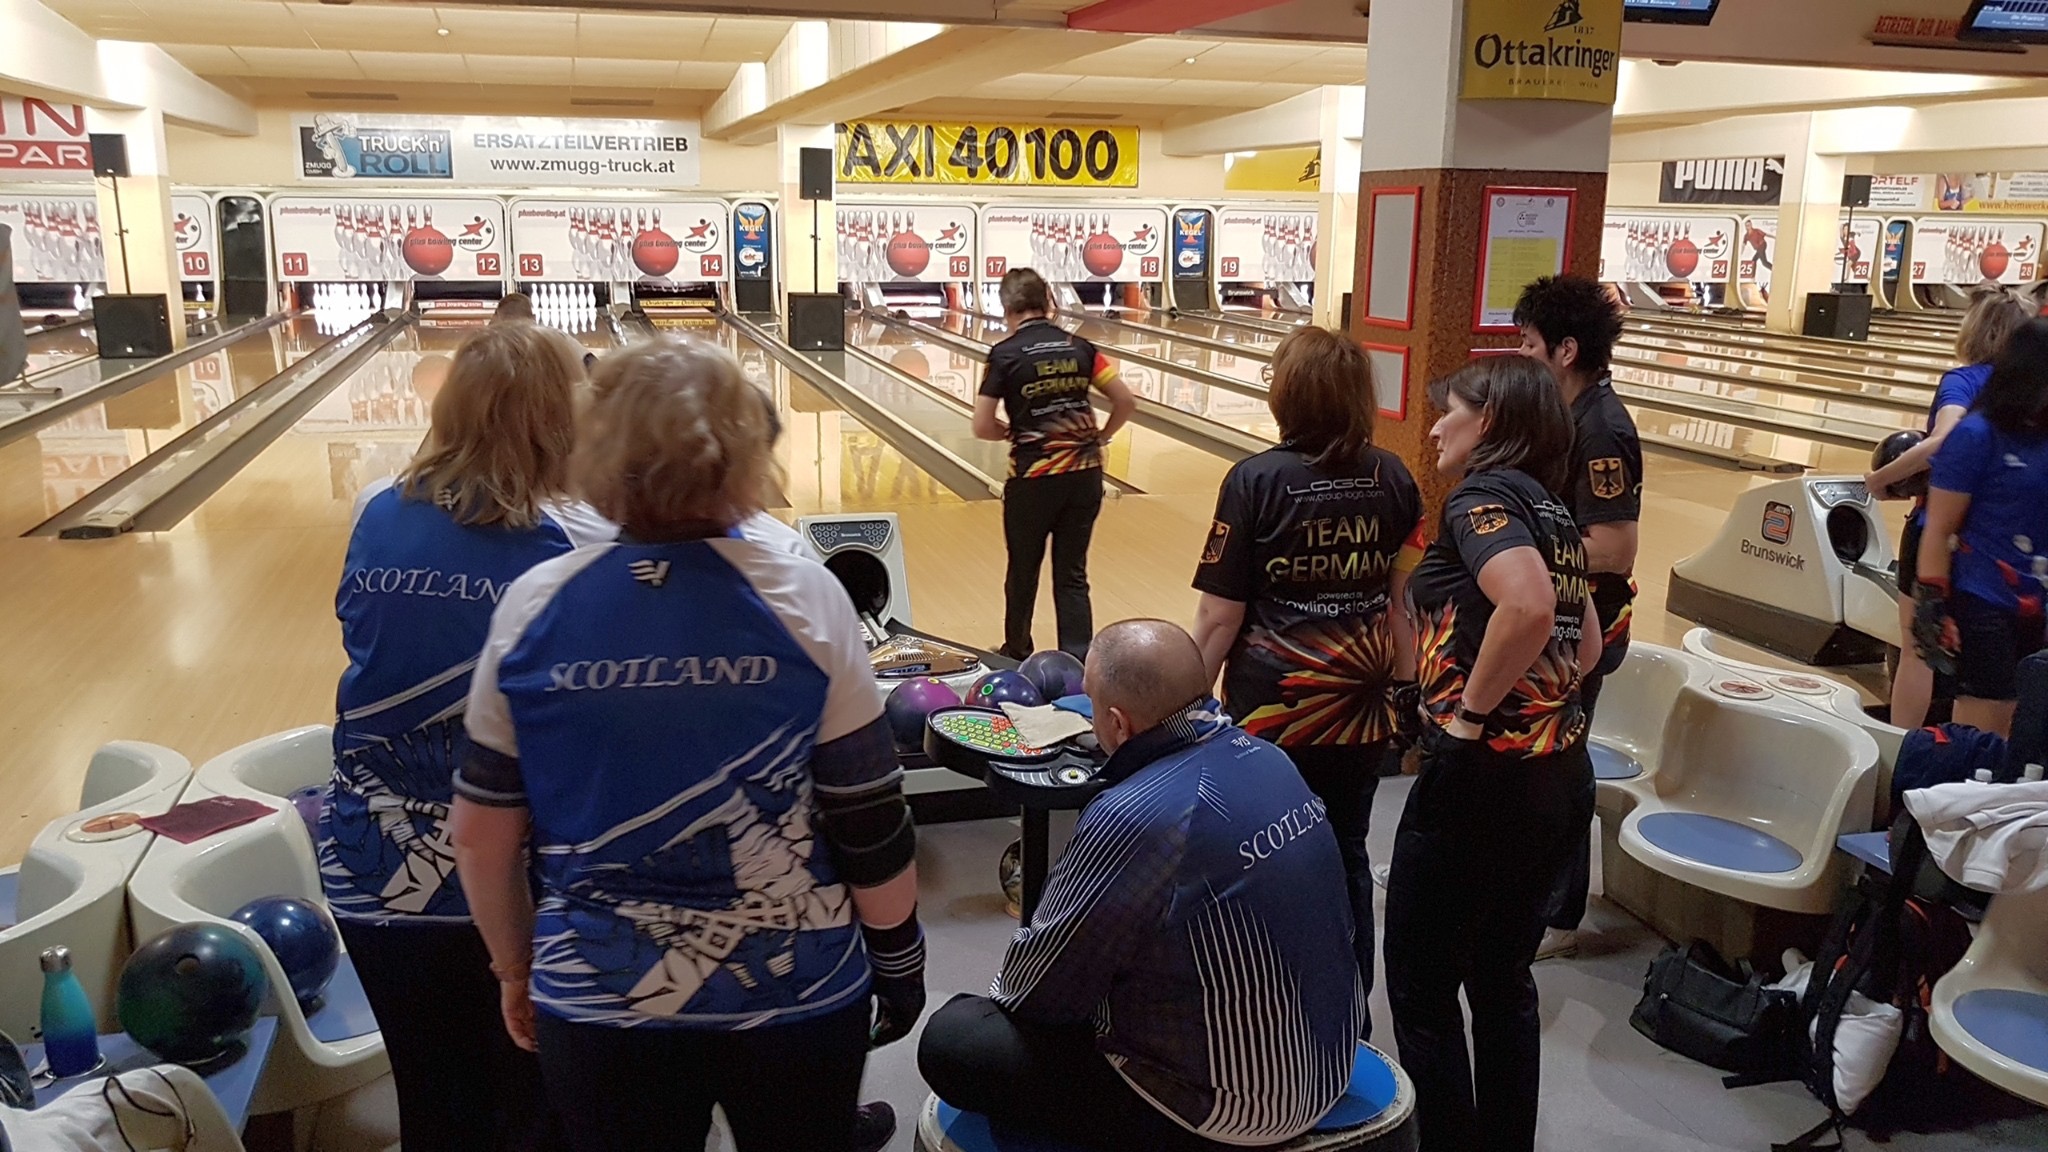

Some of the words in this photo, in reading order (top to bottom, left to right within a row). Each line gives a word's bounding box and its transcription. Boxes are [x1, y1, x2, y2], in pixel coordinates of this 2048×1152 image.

[1475, 33, 1616, 78] Ottakringer
[473, 133, 689, 151] ERSATZTEILVERTRIEB
[948, 125, 1119, 181] 40100
[361, 153, 447, 175] ROLL
[490, 157, 675, 175] www.zmugg-truck.at
[1871, 176, 1919, 186] ORTELF
[738, 224, 765, 232] KEGEL
[458, 238, 483, 246] center
[935, 242, 956, 250] center
[185, 257, 206, 271] 10
[284, 257, 306, 270] 11
[478, 257, 497, 271] 12
[522, 258, 540, 272] 13
[702, 259, 720, 272] 14
[951, 260, 967, 273] 16
[988, 261, 1004, 273] 17
[1142, 261, 1157, 273] 18
[1222, 261, 1237, 272] 19
[1713, 263, 1726, 275] 24
[1740, 264, 1753, 275] 25
[1855, 265, 1868, 275] 26
[1913, 265, 1924, 275] 27
[2021, 265, 2032, 276] 28
[1033, 358, 1078, 377] TEAM
[1302, 515, 1380, 548] TEAM
[1741, 538, 1805, 572] Brunswick
[1265, 551, 1398, 583] GERMAN
[353, 567, 513, 605] SCOTLAN
[544, 654, 778, 692] SCOTLAND
